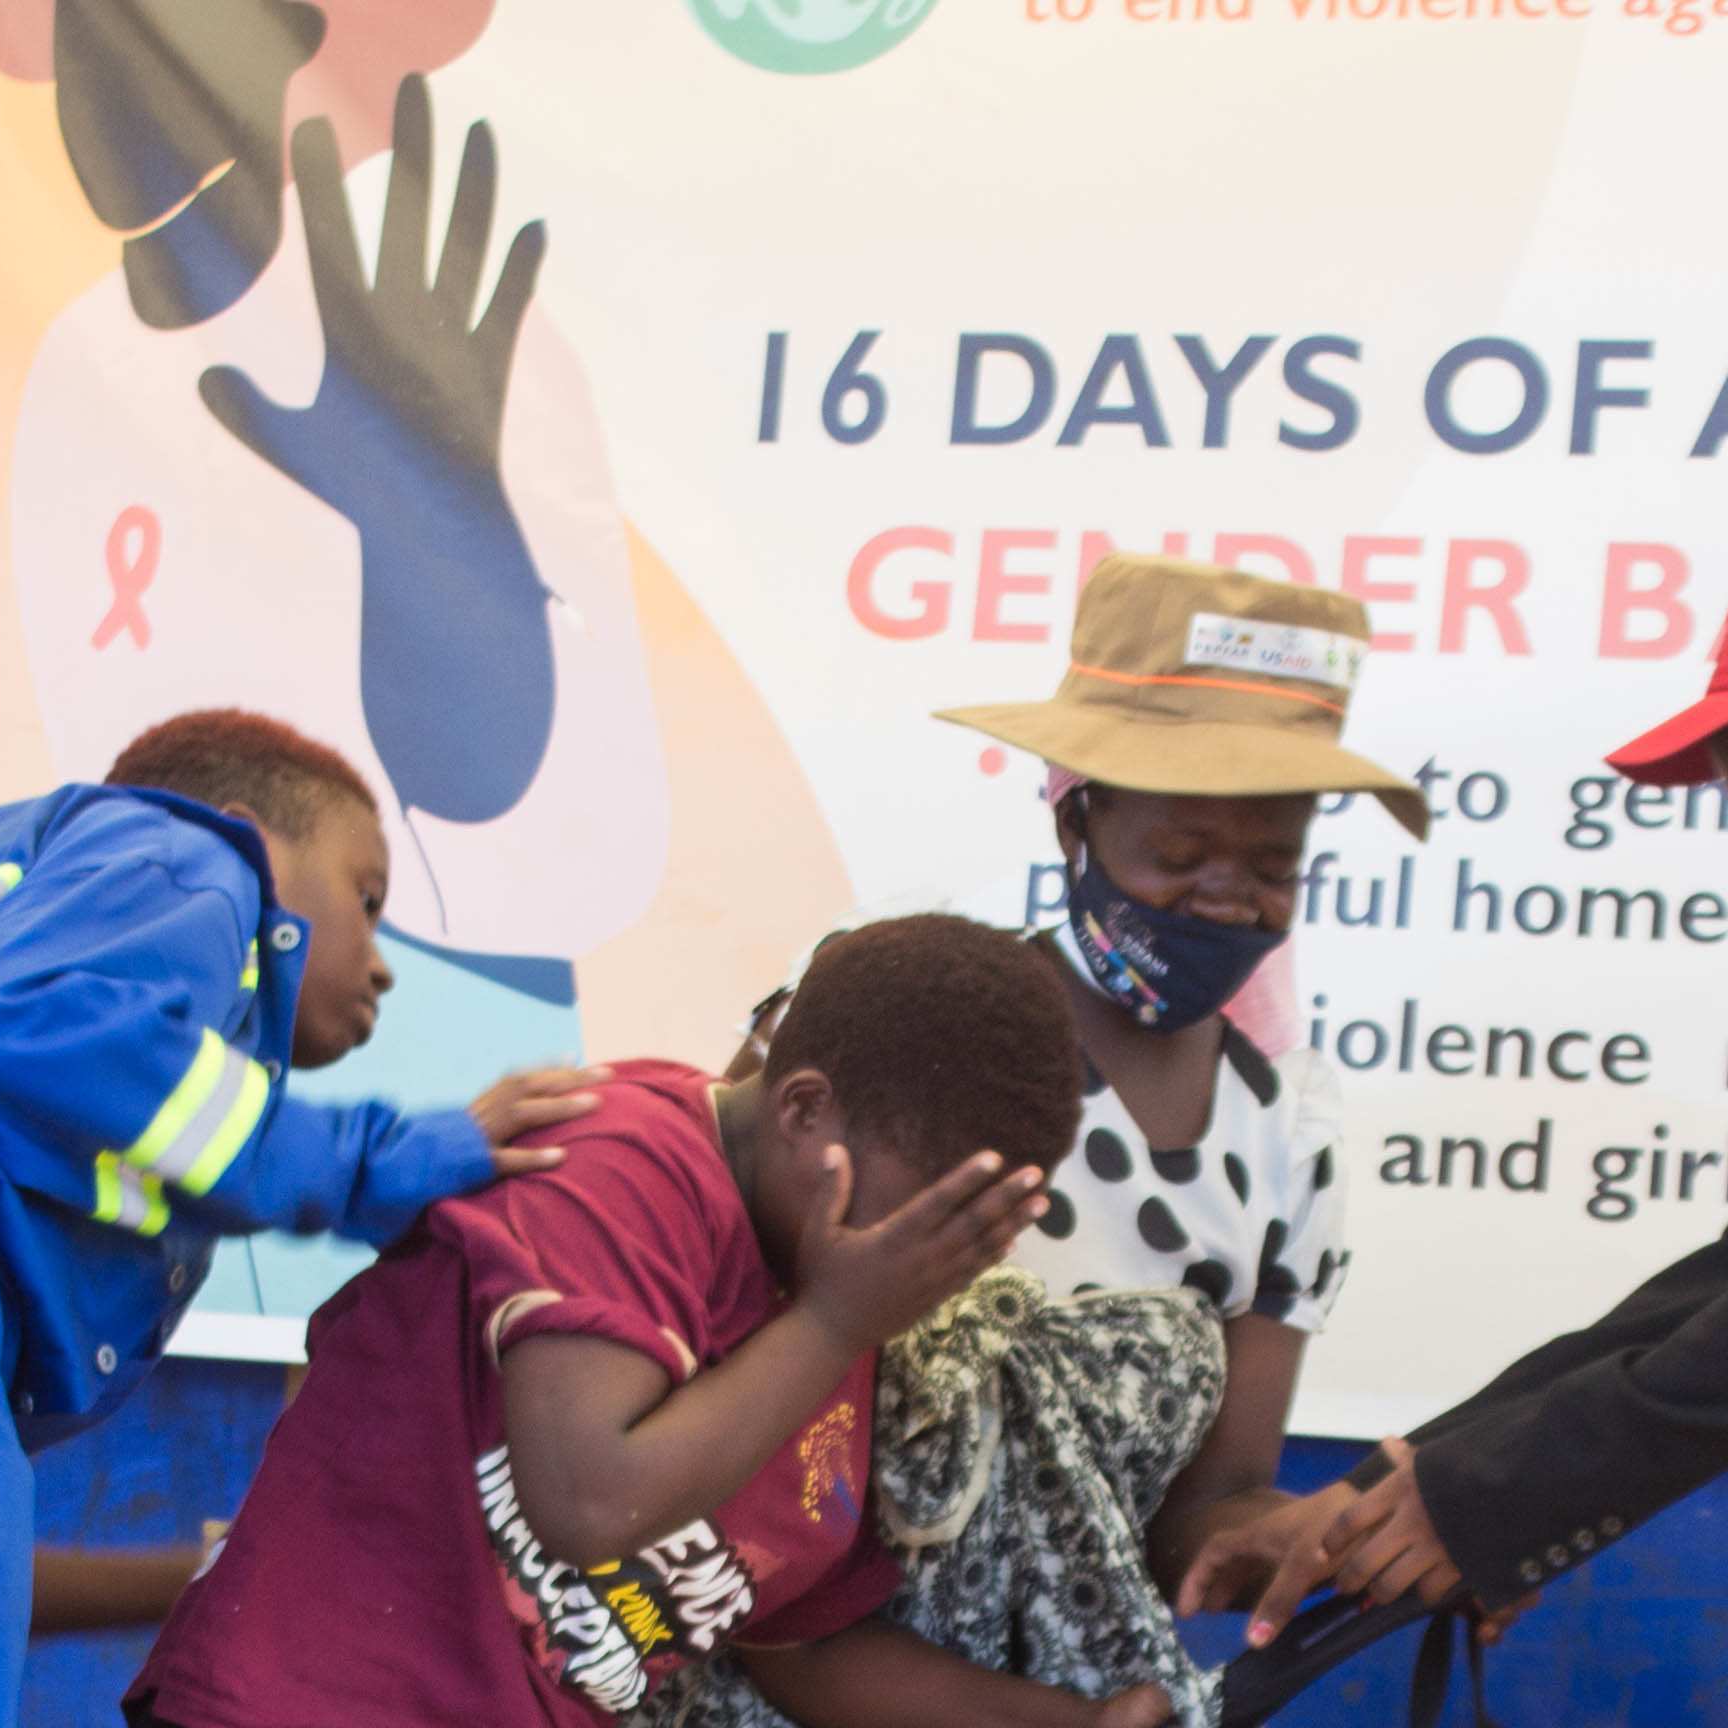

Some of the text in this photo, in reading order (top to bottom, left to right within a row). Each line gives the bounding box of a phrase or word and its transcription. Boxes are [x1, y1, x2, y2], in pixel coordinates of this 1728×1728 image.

[758, 330, 889, 446] 16
[949, 332, 1364, 452] DAYS
[1423, 336, 1655, 456] OF
[846, 524, 1535, 657] GEER
[1308, 993, 1653, 1084] iolence
[1378, 1117, 1554, 1195] and
